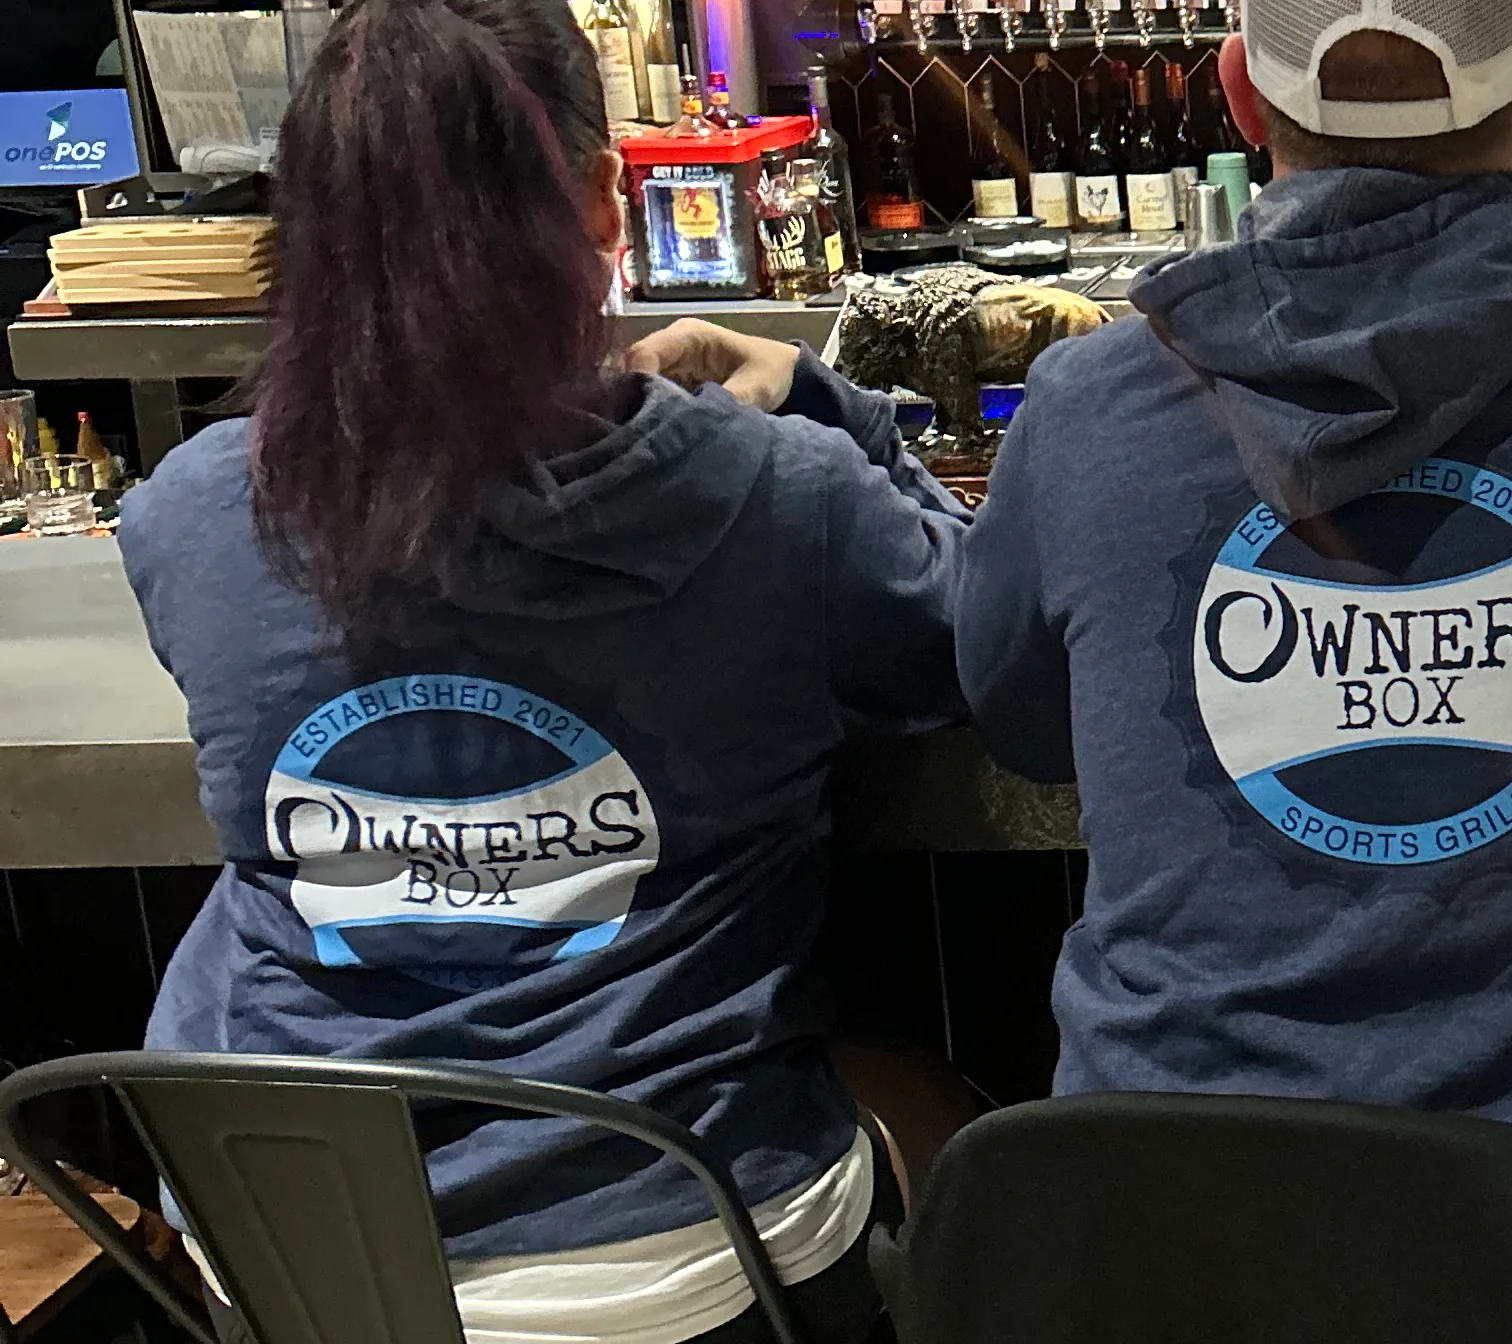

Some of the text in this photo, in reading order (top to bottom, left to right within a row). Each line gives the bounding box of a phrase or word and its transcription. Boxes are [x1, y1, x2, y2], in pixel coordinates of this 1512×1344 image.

[5, 141, 107, 162] onePOS
[290, 682, 587, 759] ESTABLISHED 2021
[1336, 676, 1465, 731] BOX
[273, 789, 646, 870] OWNERS
[1279, 806, 1419, 858] SPORTS
[400, 857, 520, 908] BOX
